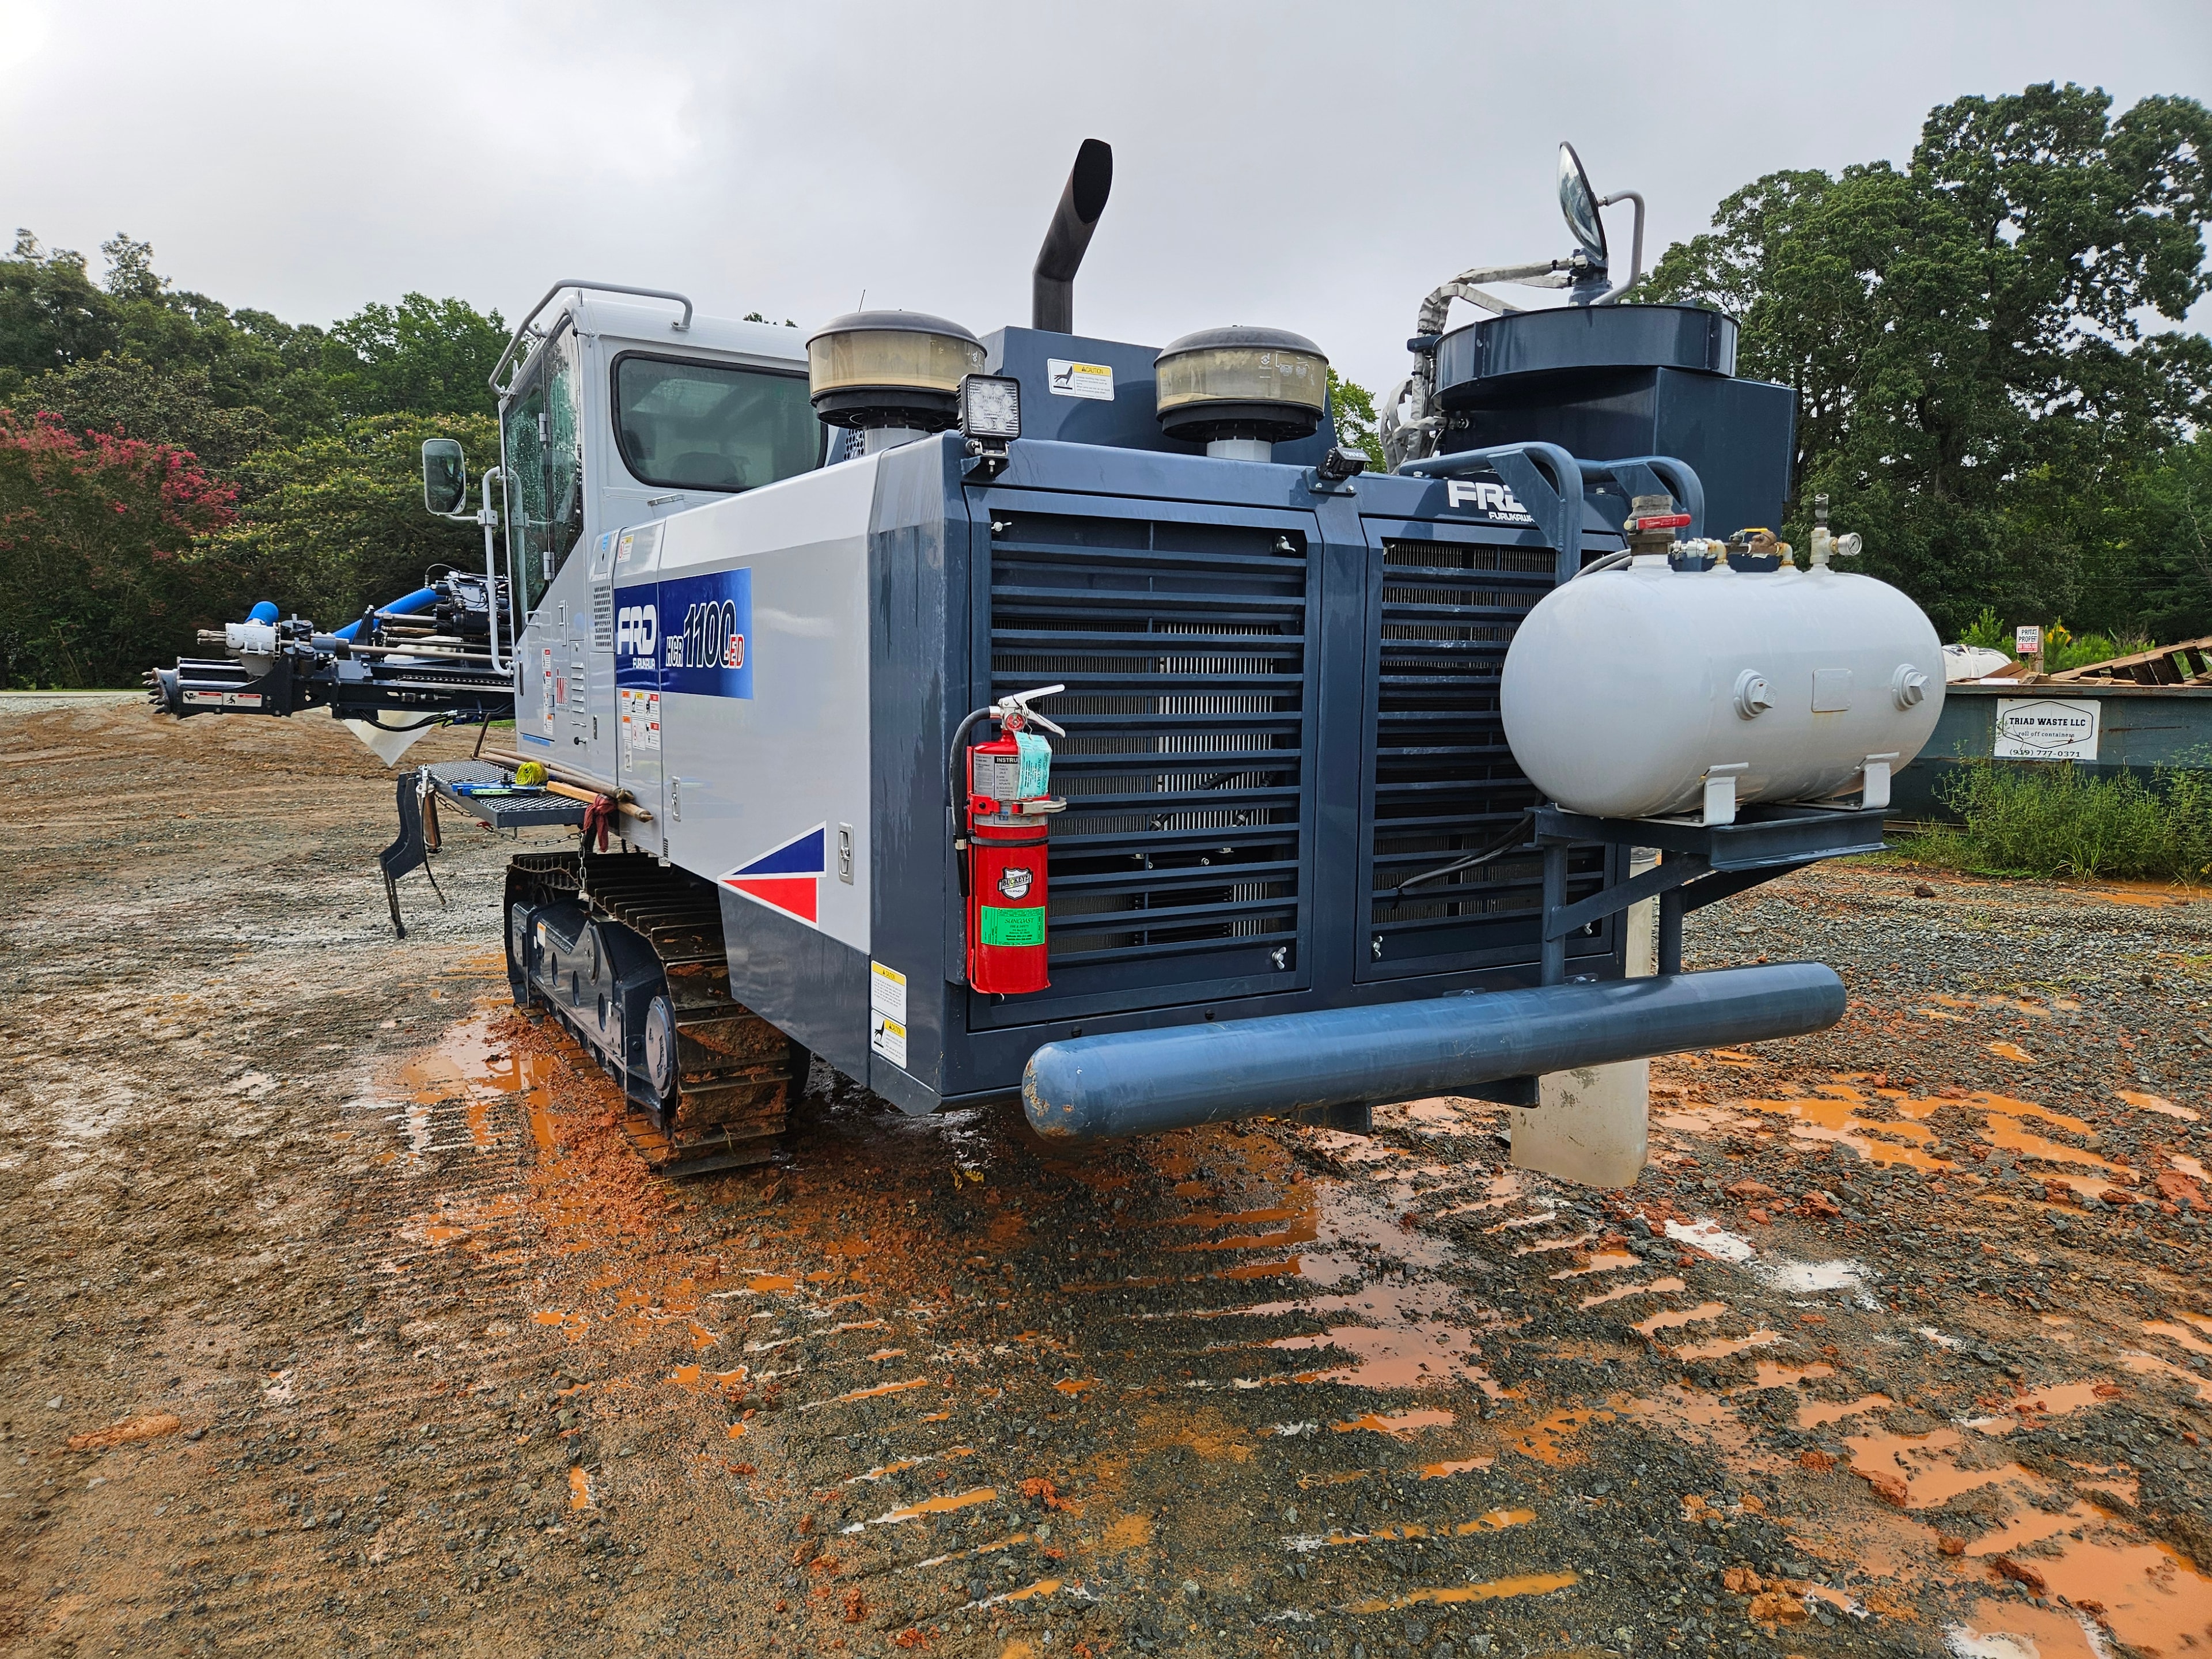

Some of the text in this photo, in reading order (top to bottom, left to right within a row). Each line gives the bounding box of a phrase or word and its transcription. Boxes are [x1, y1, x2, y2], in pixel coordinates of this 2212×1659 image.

[1086, 366, 1104, 374] CAUTION
[1488, 512, 1535, 522] FURUKAWA
[617, 604, 657, 655] FRD
[2009, 717, 2086, 727] TRIAD WASTE LLC
[2036, 749, 2081, 757] 777-0371
[1002, 874, 1029, 887] BUCKEYE
